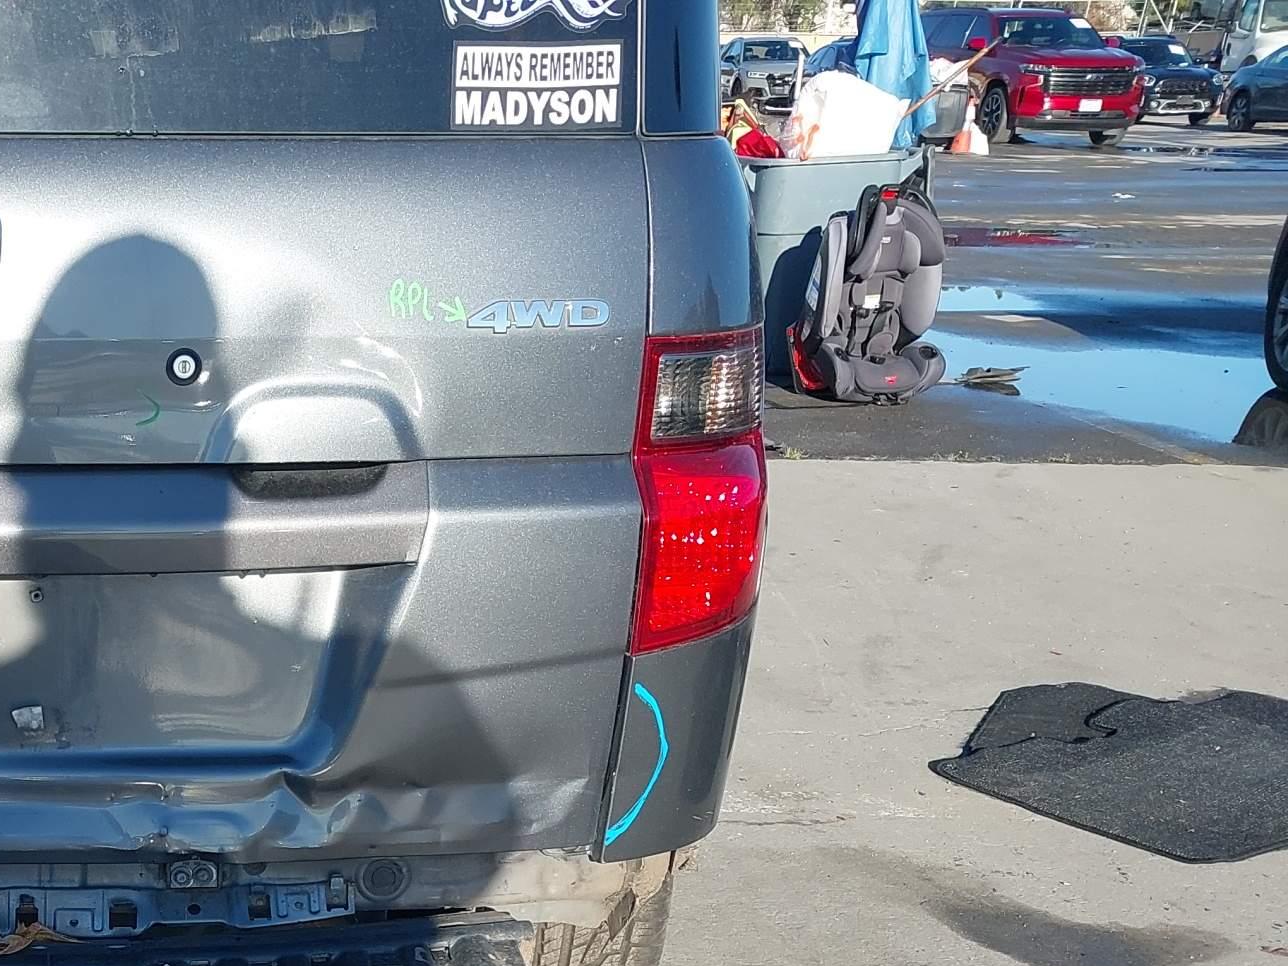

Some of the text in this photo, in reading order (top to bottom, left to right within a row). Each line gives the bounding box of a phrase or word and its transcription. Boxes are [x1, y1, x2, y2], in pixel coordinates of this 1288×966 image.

[459, 50, 616, 82] ALWAYS REMEMBER
[454, 88, 618, 126] MADYSON
[466, 298, 611, 335] 4WD
